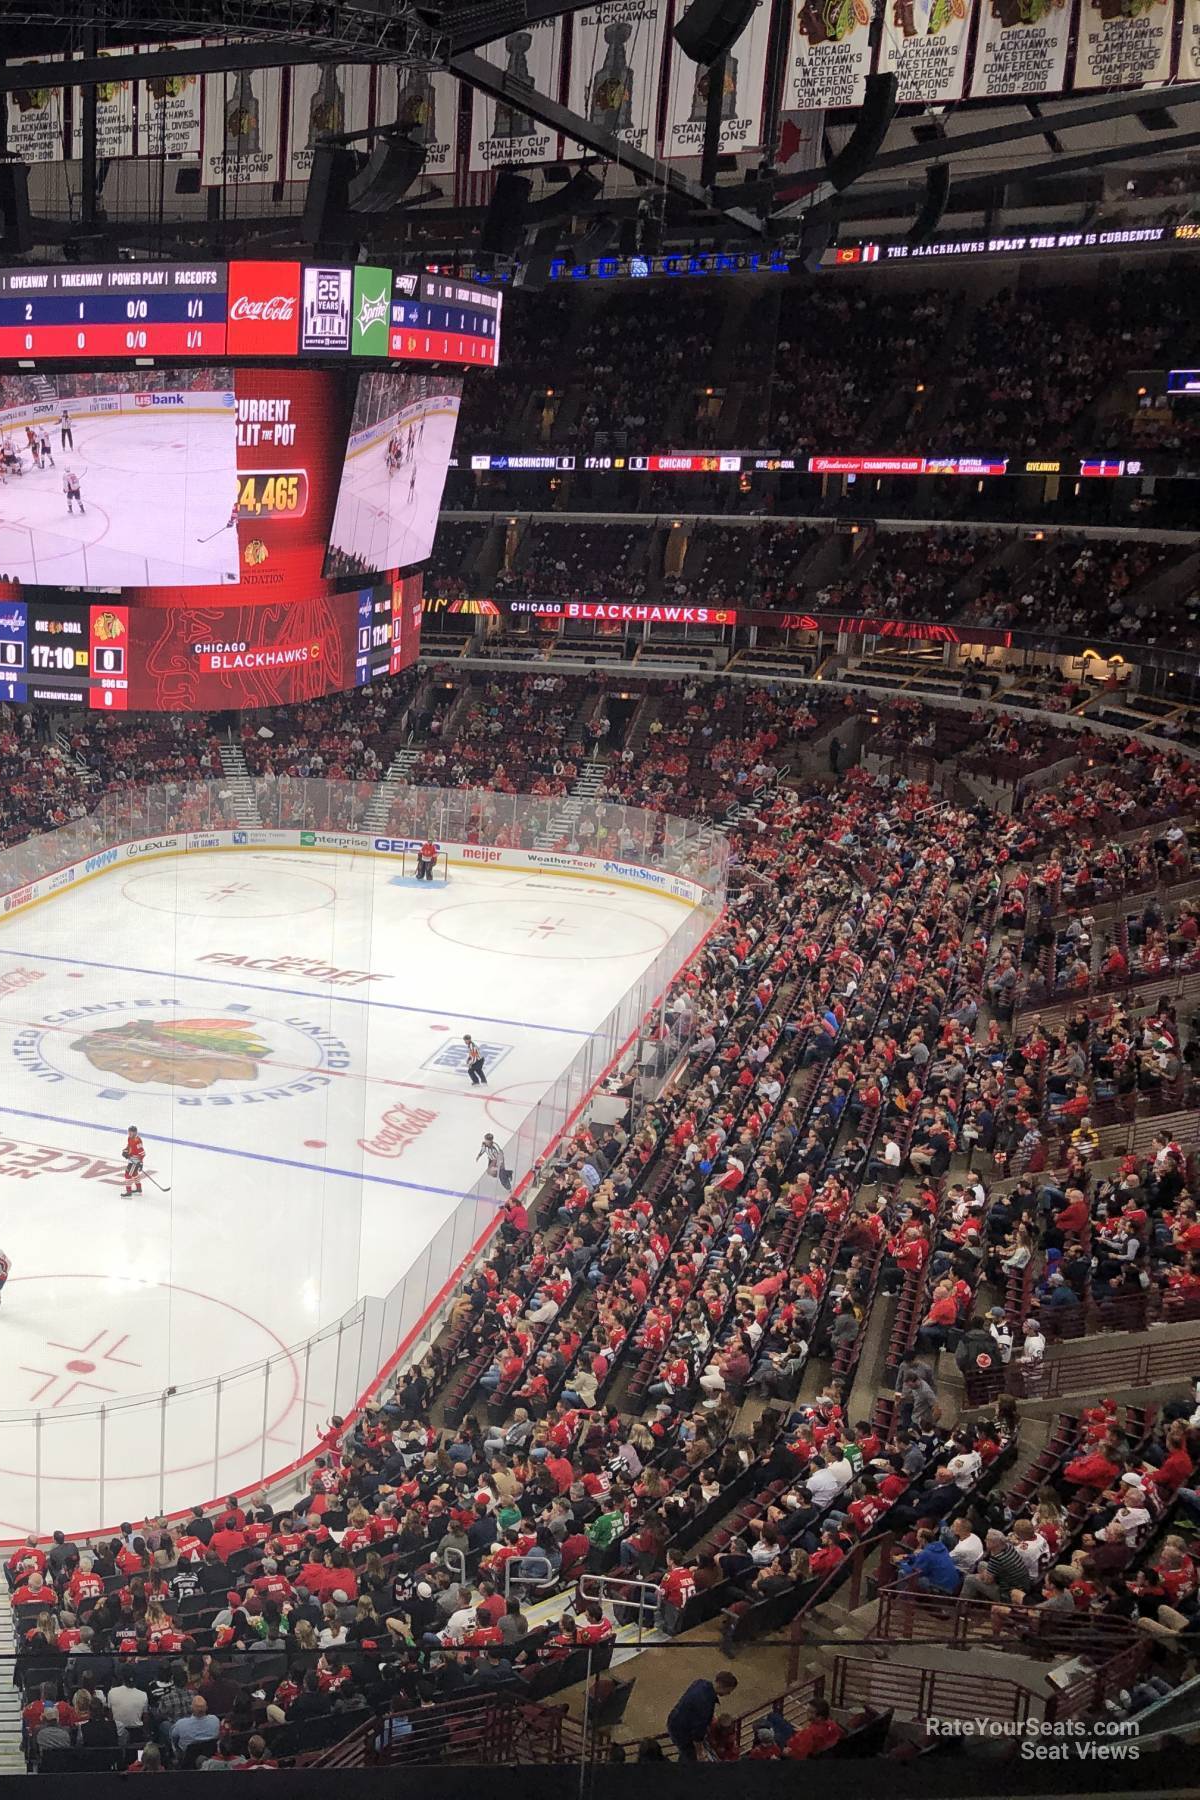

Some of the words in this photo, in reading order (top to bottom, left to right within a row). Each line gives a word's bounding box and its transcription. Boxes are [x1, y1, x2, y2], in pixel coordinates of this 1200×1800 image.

[595, 1, 645, 14] CHICAGO
[581, 10, 658, 26] BLACKHAWKS
[1103, 18, 1150, 31] CHICAGO
[1001, 28, 1045, 40] CHICAGO
[1089, 27, 1163, 44] BLACKHAWKS
[903, 36, 946, 48] CHICAGO
[986, 38, 1057, 52] BLACKHAWKS
[1096, 40, 1155, 53] CAMPBELL
[808, 44, 850, 56] CHICAGO
[889, 46, 958, 59] BLACKHAWKS
[994, 51, 1046, 62] WESTERN
[796, 54, 862, 66] BLACKHAWKS
[896, 57, 947, 69] WESTERN
[1088, 50, 1160, 65] CONFERENCE
[803, 65, 852, 77] WESTERN
[984, 59, 1054, 73] CONFERENCE
[1092, 61, 1154, 75] CHAMPIONS
[896, 67, 955, 80] ONFERENCE
[988, 71, 1048, 84] CHAMPIONS
[1102, 73, 1143, 84] 1991-92
[793, 75, 859, 88] CONFERENCE
[987, 81, 1046, 94] 2009-2010
[798, 86, 853, 97] CHAMPIONS
[898, 90, 937, 100] 2012-13
[798, 97, 851, 108] 2014-2015
[728, 120, 752, 130] CUP
[478, 139, 523, 150] STANLEY
[528, 137, 550, 146] CUP
[210, 156, 249, 165] STANLEY
[254, 154, 273, 163] CUP
[483, 147, 545, 160] CHAMPIONS
[214, 164, 269, 174] CHAMPIONS
[888, 247, 907, 258] THE
[913, 242, 984, 256] BLACKHAWKS
[989, 238, 1025, 251] SPLIT
[1030, 237, 1055, 248] THE
[1059, 235, 1082, 246] POT
[1085, 233, 1096, 244] IS
[1100, 229, 1164, 244] CURRENTLY
[11, 275, 48, 289] GIVEAWAY
[61, 273, 102, 287] TAKEAWAY
[112, 272, 145, 286] POWER
[148, 272, 164, 285] PLAY
[175, 271, 217, 285] FACEOFFS
[319, 281, 338, 300] 25
[25, 304, 32, 320] 2
[127, 301, 147, 318] 0/0
[230, 296, 297, 321] Coca-Cola
[319, 302, 339, 311] YEARS
[360, 304, 387, 322] Sprite
[126, 332, 147, 348] 0/0
[274, 424, 296, 446] POT
[508, 457, 555, 468] WASHINGTON
[562, 458, 569, 468] 0
[584, 457, 611, 468] 17:10
[635, 458, 642, 468] 0
[659, 458, 691, 469] CHICAGO
[864, 461, 900, 470] CHAMPIONS
[902, 462, 918, 470] CLUB
[1026, 462, 1060, 472] GIVEAWAYS
[511, 602, 561, 613] CHICAGO
[569, 604, 708, 622] BLACKHAWKS
[35, 621, 48, 632] ONE
[63, 622, 82, 634] GOAL
[195, 642, 246, 653] CHICAGO
[7, 647, 15, 663] 0
[31, 646, 74, 669] 17:10
[103, 650, 114, 670] 0
[211, 648, 308, 668] BLACKHAWKS
[6, 673, 17, 681] SOG
[102, 679, 115, 688] SOG
[8, 685, 14, 699] 1
[105, 691, 112, 706] 0
[34, 690, 82, 701] BLACKHAWKS.COM
[138, 839, 177, 852] LEXUS
[463, 848, 502, 862] meijer
[528, 854, 596, 869] WeatherTech
[611, 862, 665, 884] NorthShore
[195, 952, 395, 983] FACE-OFF
[43, 998, 184, 1023] CENTER
[178, 1075, 332, 1106] CENTER
[357, 1101, 441, 1158] Coca-Cola
